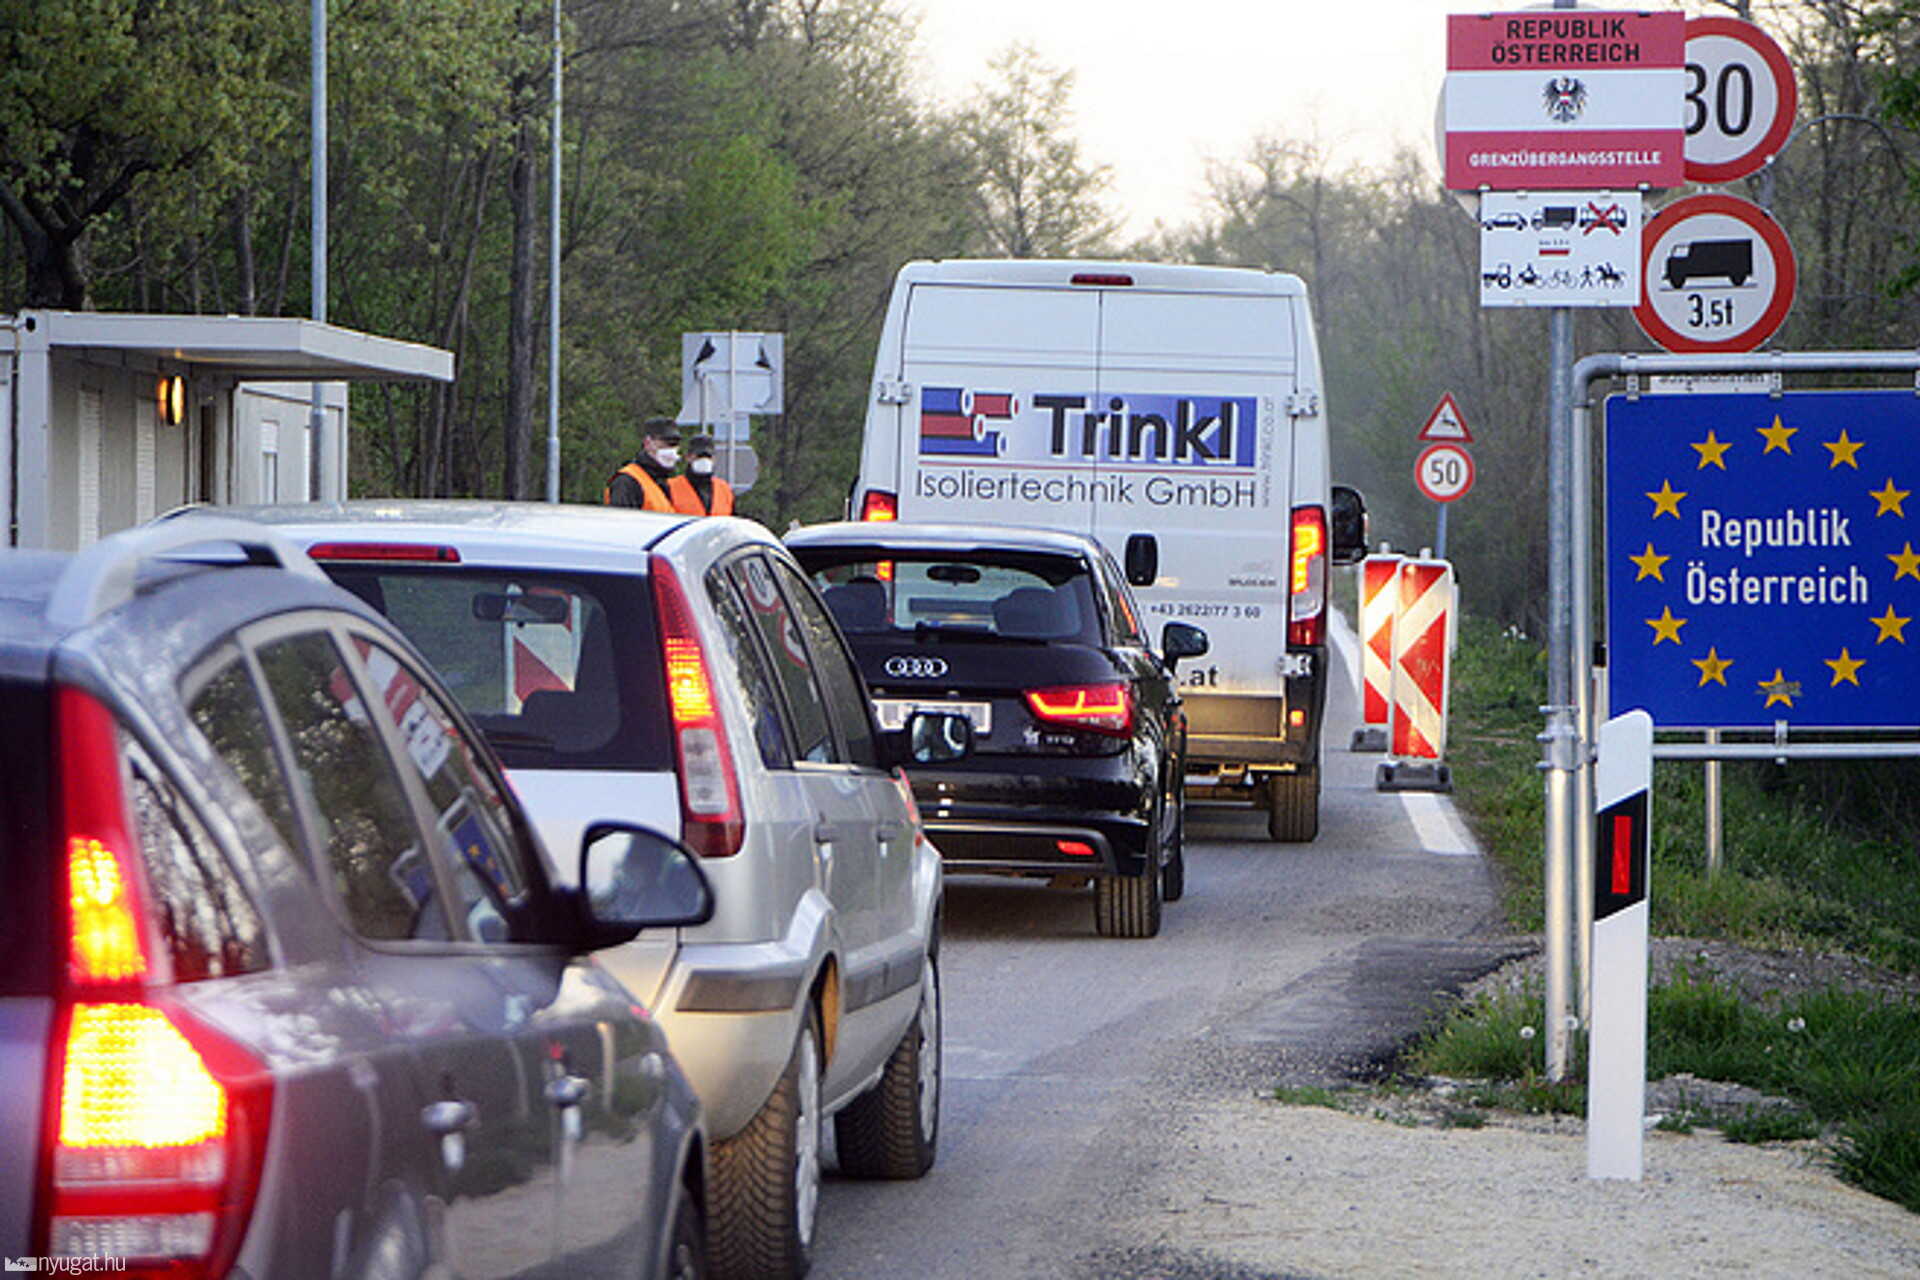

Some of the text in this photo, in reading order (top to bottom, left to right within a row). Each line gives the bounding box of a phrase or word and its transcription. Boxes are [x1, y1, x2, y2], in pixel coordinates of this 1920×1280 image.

[1507, 20, 1625, 38] REPUBLIK
[1492, 40, 1640, 63] ÖSTERREICH
[1469, 150, 1661, 167] GRENZÜBERGANGSSTELLE
[1033, 396, 1238, 462] Trinkl
[1431, 459, 1460, 486] 50
[916, 470, 1256, 508] Isoliertechnik GmbH
[1701, 509, 1851, 557] Republik
[1686, 561, 1868, 604] Österreich
